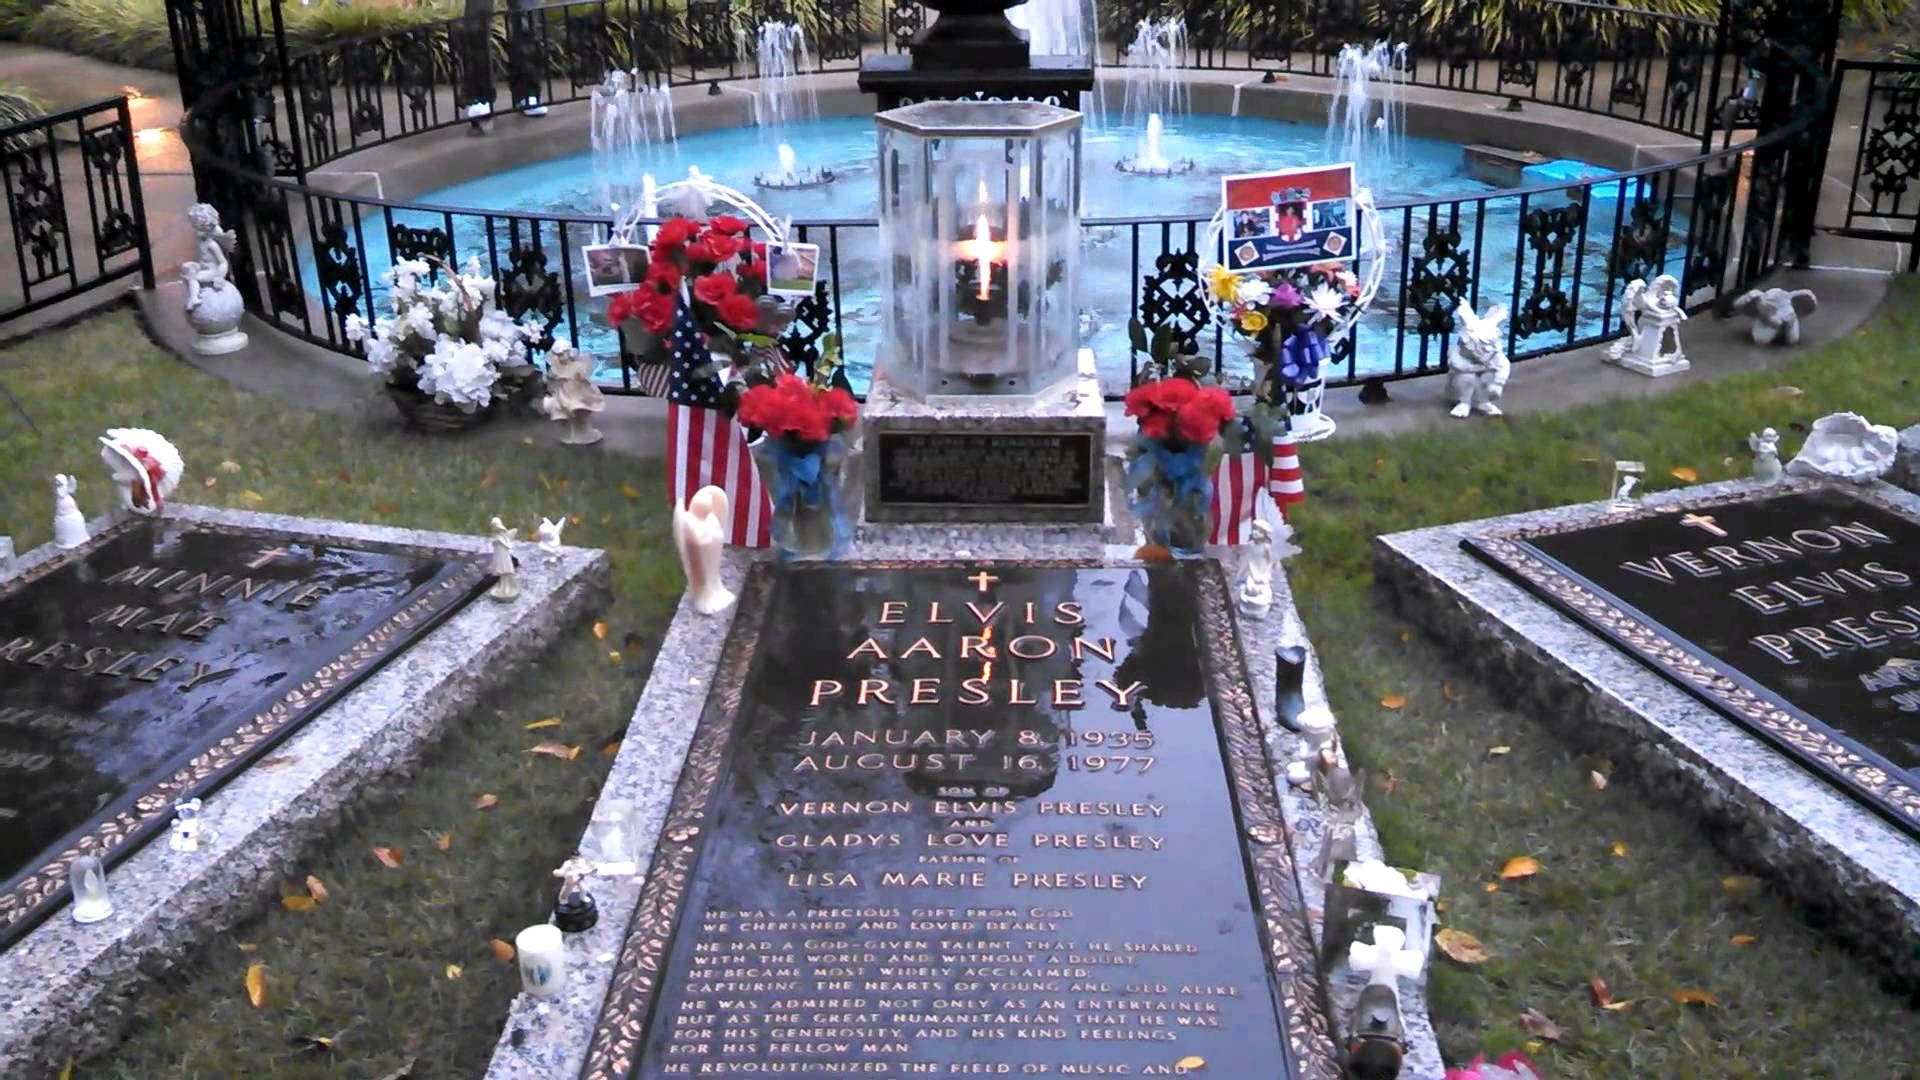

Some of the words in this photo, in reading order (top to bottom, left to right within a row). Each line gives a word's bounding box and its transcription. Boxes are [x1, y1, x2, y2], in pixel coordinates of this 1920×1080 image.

[1618, 520, 1895, 585] VERNON
[101, 564, 334, 609] MINNIE
[1729, 561, 1913, 616] ELVIS
[878, 600, 1086, 626] ELVIS
[86, 603, 227, 640] MAE
[845, 635, 1118, 662] AARON
[807, 679, 1147, 710] PRESLEY
[798, 729, 996, 747] JANUARY
[1066, 730, 1155, 750] 1935
[793, 753, 974, 773] AUGUST
[1066, 755, 1156, 774] 1977
[779, 801, 912, 816] VERNON
[934, 800, 1017, 815] ELVIS
[1039, 801, 1168, 818] PRESLEY
[950, 820, 993, 828] AND
[776, 834, 902, 848] GLADYS
[927, 833, 1009, 847] LOVE
[1034, 834, 1167, 850] PRESLEY
[919, 855, 987, 864] FATHER
[788, 873, 858, 887] LISA
[882, 872, 986, 887] MARIE
[1013, 873, 1148, 890] PRESLEY
[705, 911, 729, 920] HE
[807, 908, 900, 918] PRECIOUS
[912, 908, 956, 918] GIFT
[967, 909, 1017, 918] FROM
[703, 923, 729, 932] WE
[740, 921, 848, 932] CHERISHED
[859, 921, 898, 930] AND
[910, 921, 974, 931] LOVED
[986, 921, 1057, 932] DEARLY
[695, 942, 720, 952] HE
[730, 941, 772, 951] HAD
[940, 940, 1012, 950] TALENT
[1025, 941, 1076, 951] THAT
[694, 955, 746, 965] WITH
[759, 955, 795, 964] THE
[806, 954, 875, 963] WORLD
[888, 954, 929, 963] AND
[941, 954, 1035, 964] WITHOUT
[688, 969, 713, 979] HE
[723, 968, 801, 978] BECAME
[879, 967, 951, 977] WIDELY
[686, 982, 802, 993] CAPTURING
[815, 981, 852, 991] THE
[864, 981, 943, 991] HEARTS
[954, 982, 981, 992] OF
[989, 982, 1059, 993] YOUNG
[1070, 983, 1111, 993] AND
[680, 1000, 706, 1010] HE
[771, 999, 867, 1009] ADMIRED
[878, 999, 922, 1009] NOT
[932, 999, 990, 1009] ONLY
[1003, 1000, 1027, 1009] AS
[1039, 1000, 1067, 1010] AN
[677, 1014, 717, 1025] BUT
[727, 1014, 752, 1024] AS
[763, 1013, 800, 1024] THE
[812, 1013, 881, 1023] GREAT
[892, 1013, 1060, 1024] HUMANITARIAN
[1074, 1014, 1128, 1025] THAT
[1139, 1015, 1165, 1026] HE
[1176, 1016, 1220, 1027] WAS
[673, 1029, 713, 1040] FOR
[724, 1028, 759, 1039] HIS
[770, 1028, 903, 1039] GENEROSITY
[915, 1029, 959, 1039] AND
[971, 1028, 1006, 1040] HIS
[1017, 1028, 1068, 1040] KIND
[1079, 1029, 1178, 1042] FEELINGS
[669, 1044, 709, 1055] FOR
[723, 1043, 757, 1053] HIS
[768, 1043, 850, 1054] FELLOW
[862, 1043, 910, 1053] MAN
[664, 1063, 690, 1074] HE
[899, 1062, 938, 1073] THE
[950, 1063, 1011, 1073] FIELD
[1021, 1064, 1050, 1074] OF
[1061, 1064, 1129, 1074] MUSIC
[1143, 1064, 1189, 1076] AND
